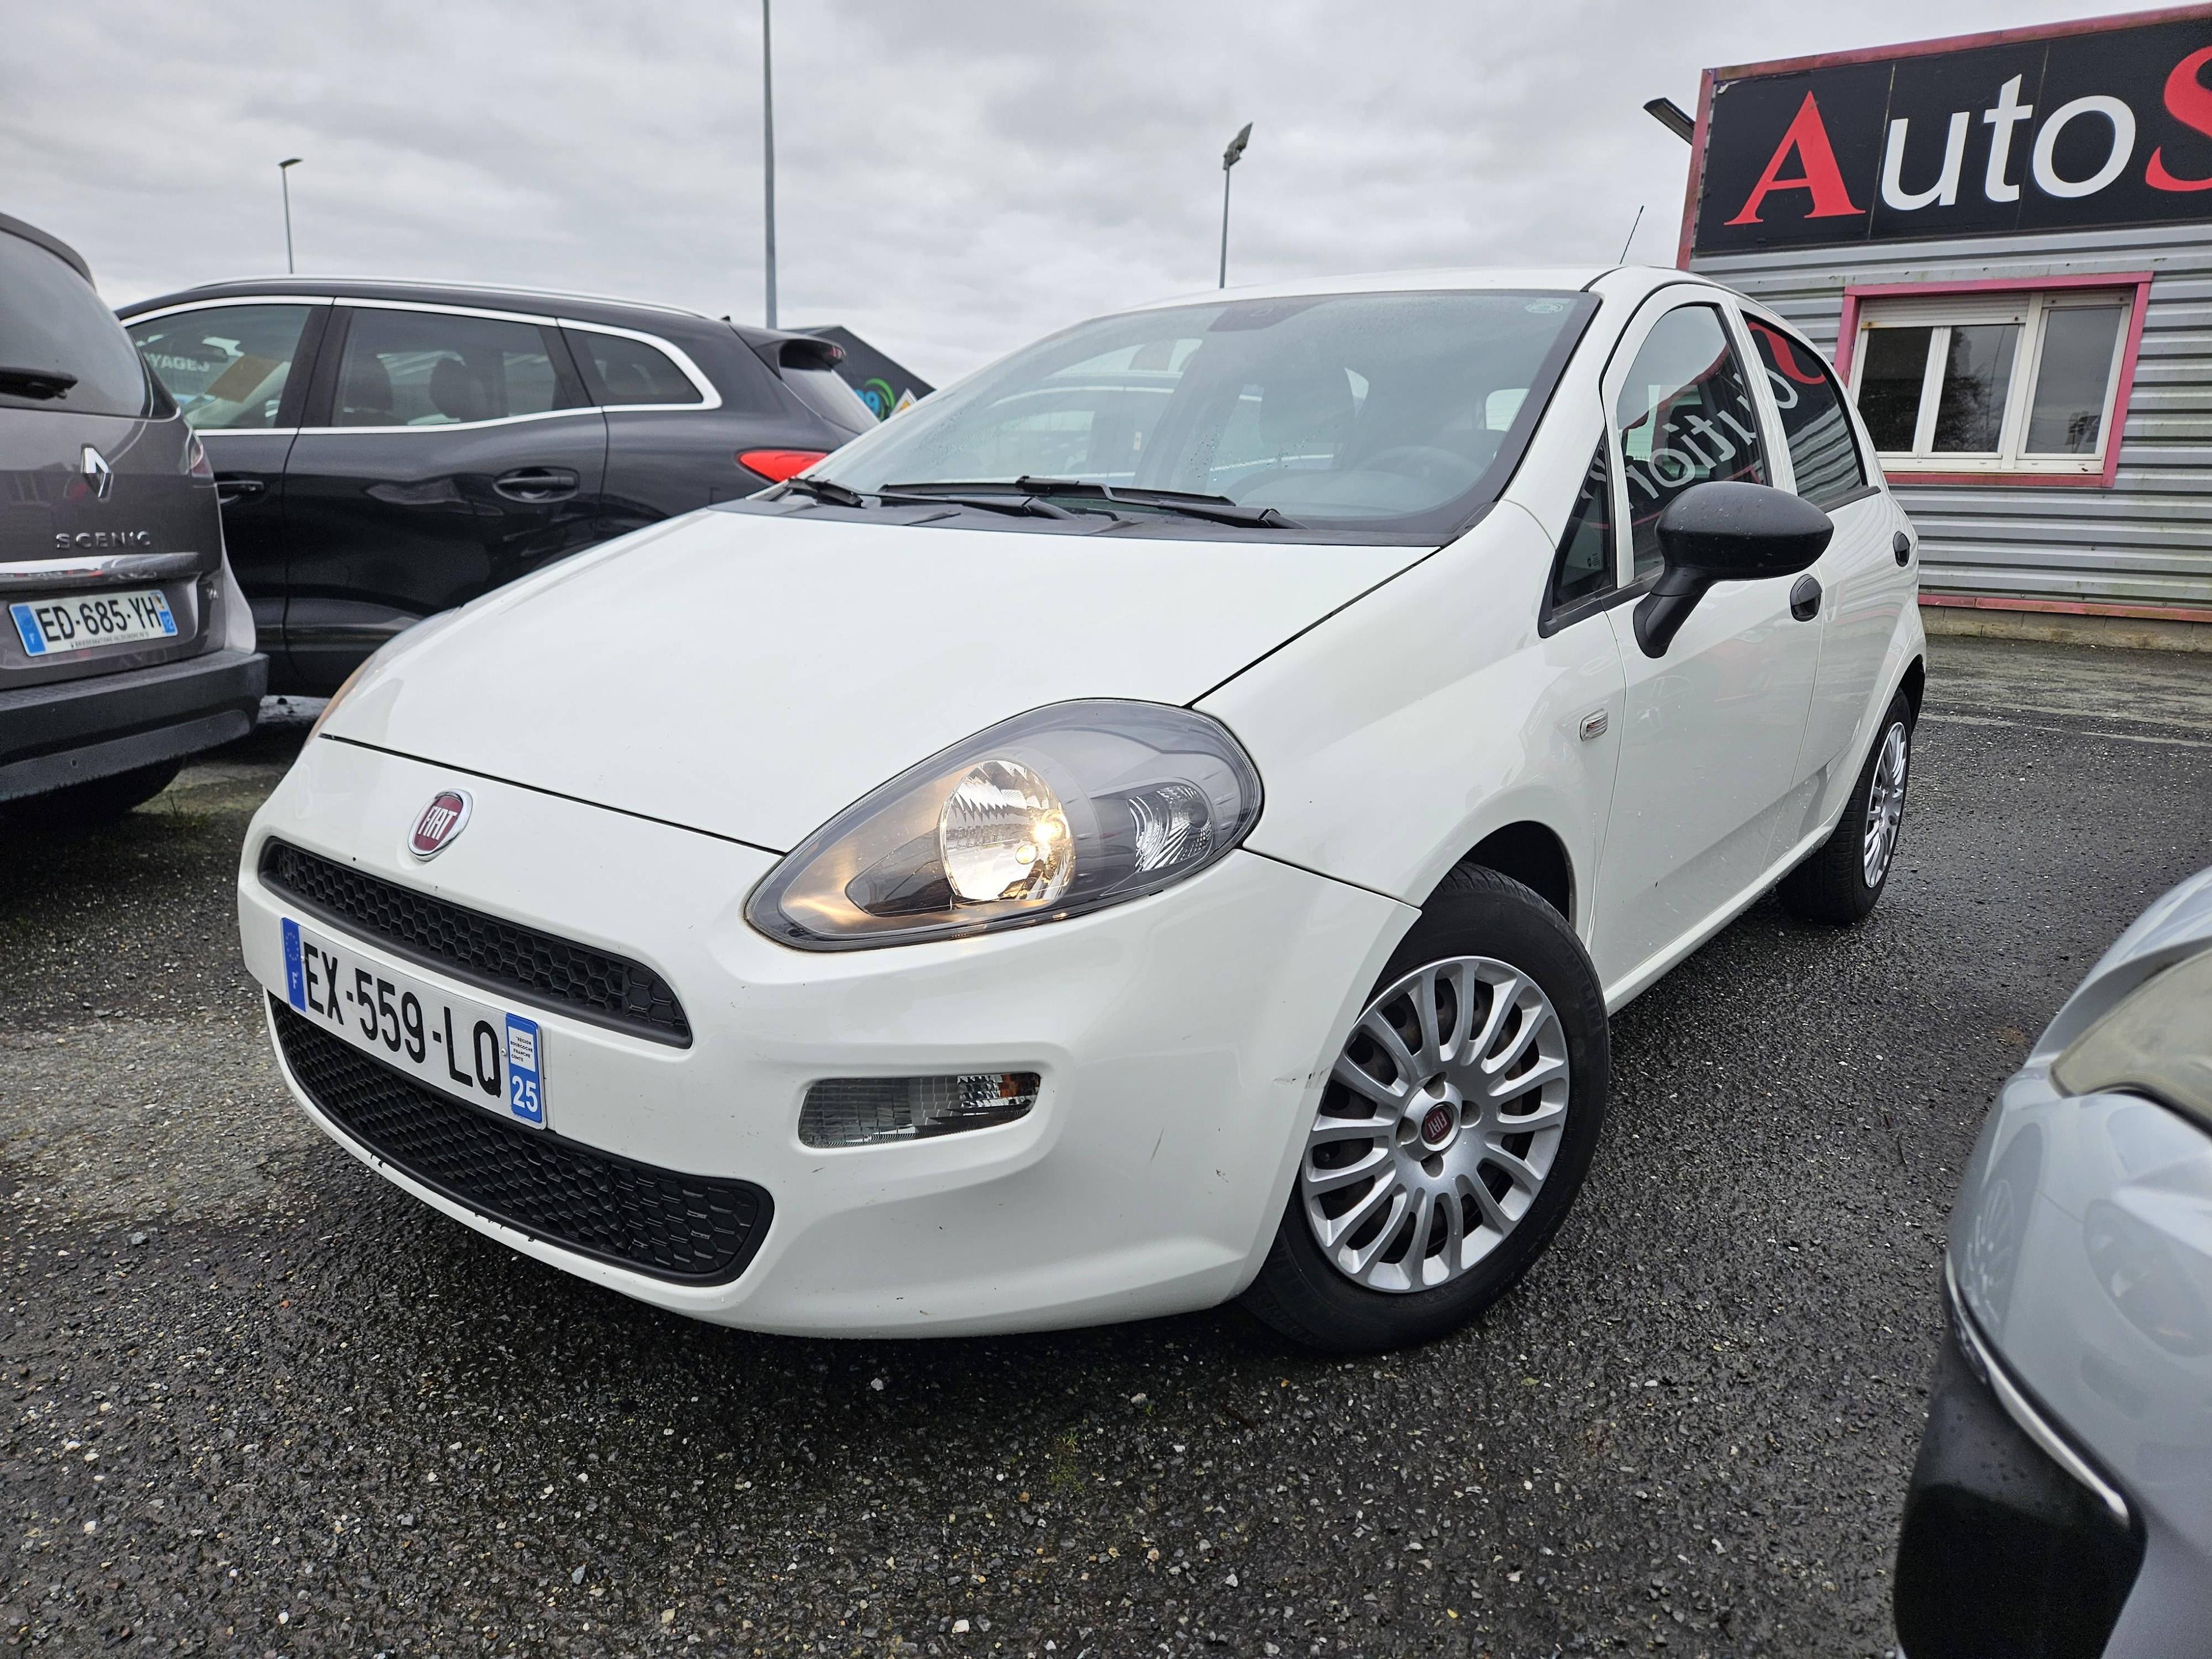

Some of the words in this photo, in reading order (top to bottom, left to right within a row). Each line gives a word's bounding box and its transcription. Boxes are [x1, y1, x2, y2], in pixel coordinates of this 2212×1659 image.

[418, 805, 459, 841] FIAT
[512, 1075, 539, 1112] 25
[1428, 1111, 1448, 1138] FIAT
